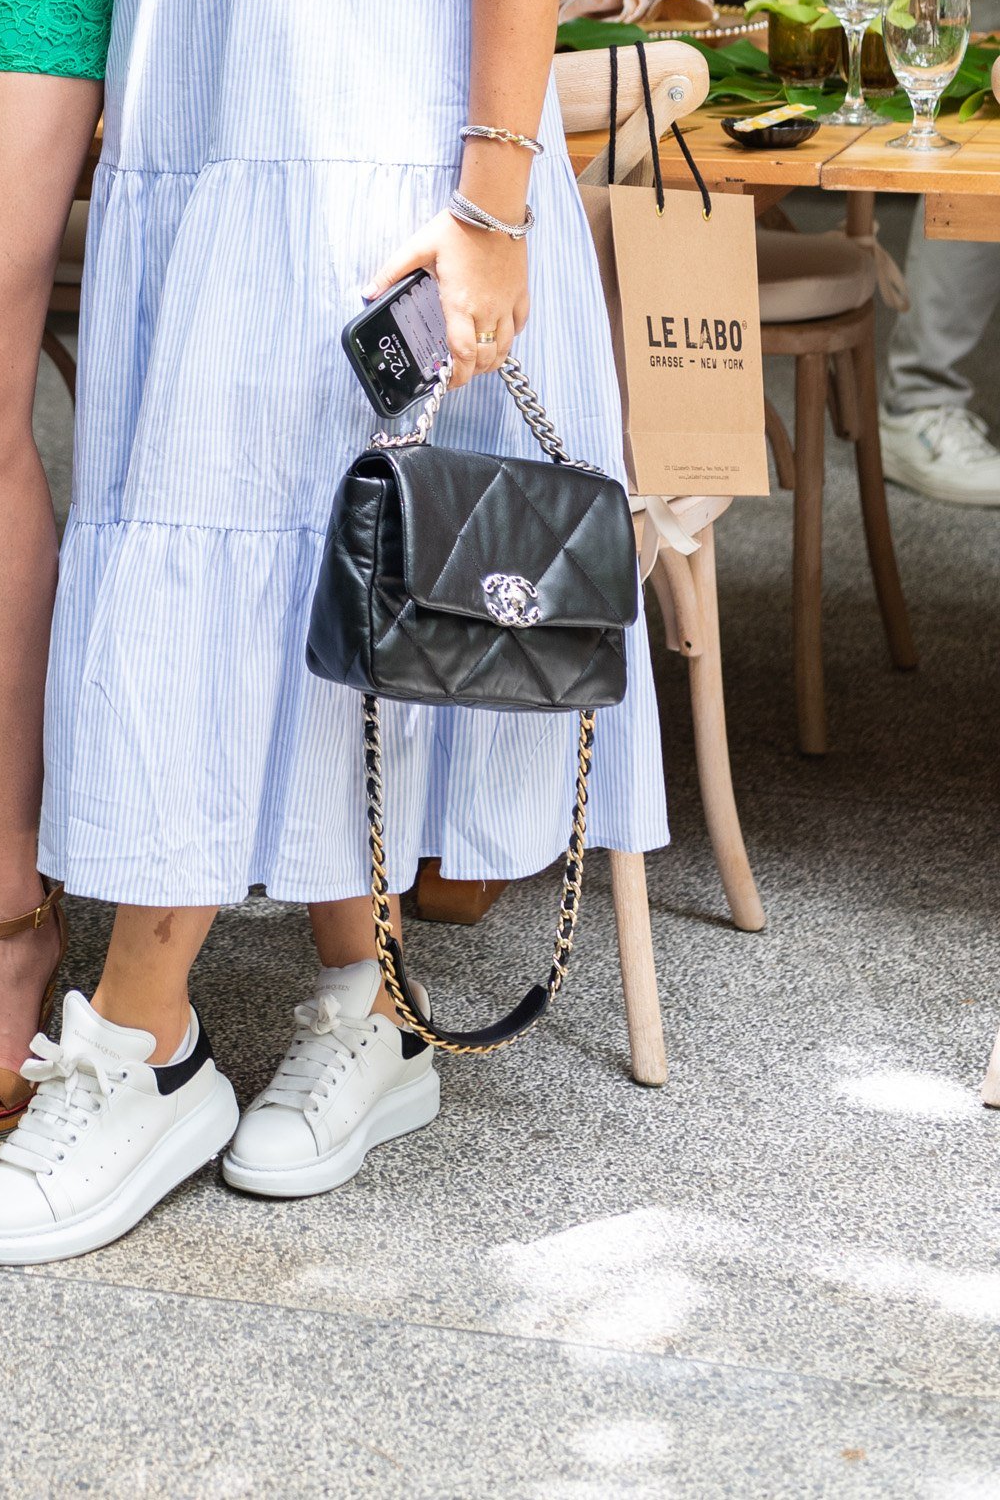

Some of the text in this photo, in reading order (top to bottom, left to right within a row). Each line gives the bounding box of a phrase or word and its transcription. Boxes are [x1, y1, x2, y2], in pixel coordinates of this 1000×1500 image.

[646, 315, 677, 348] LE
[378, 336, 406, 380] 12:20
[650, 355, 684, 368] GRASSE
[701, 358, 717, 369] NEW
[723, 359, 744, 370] YORK
